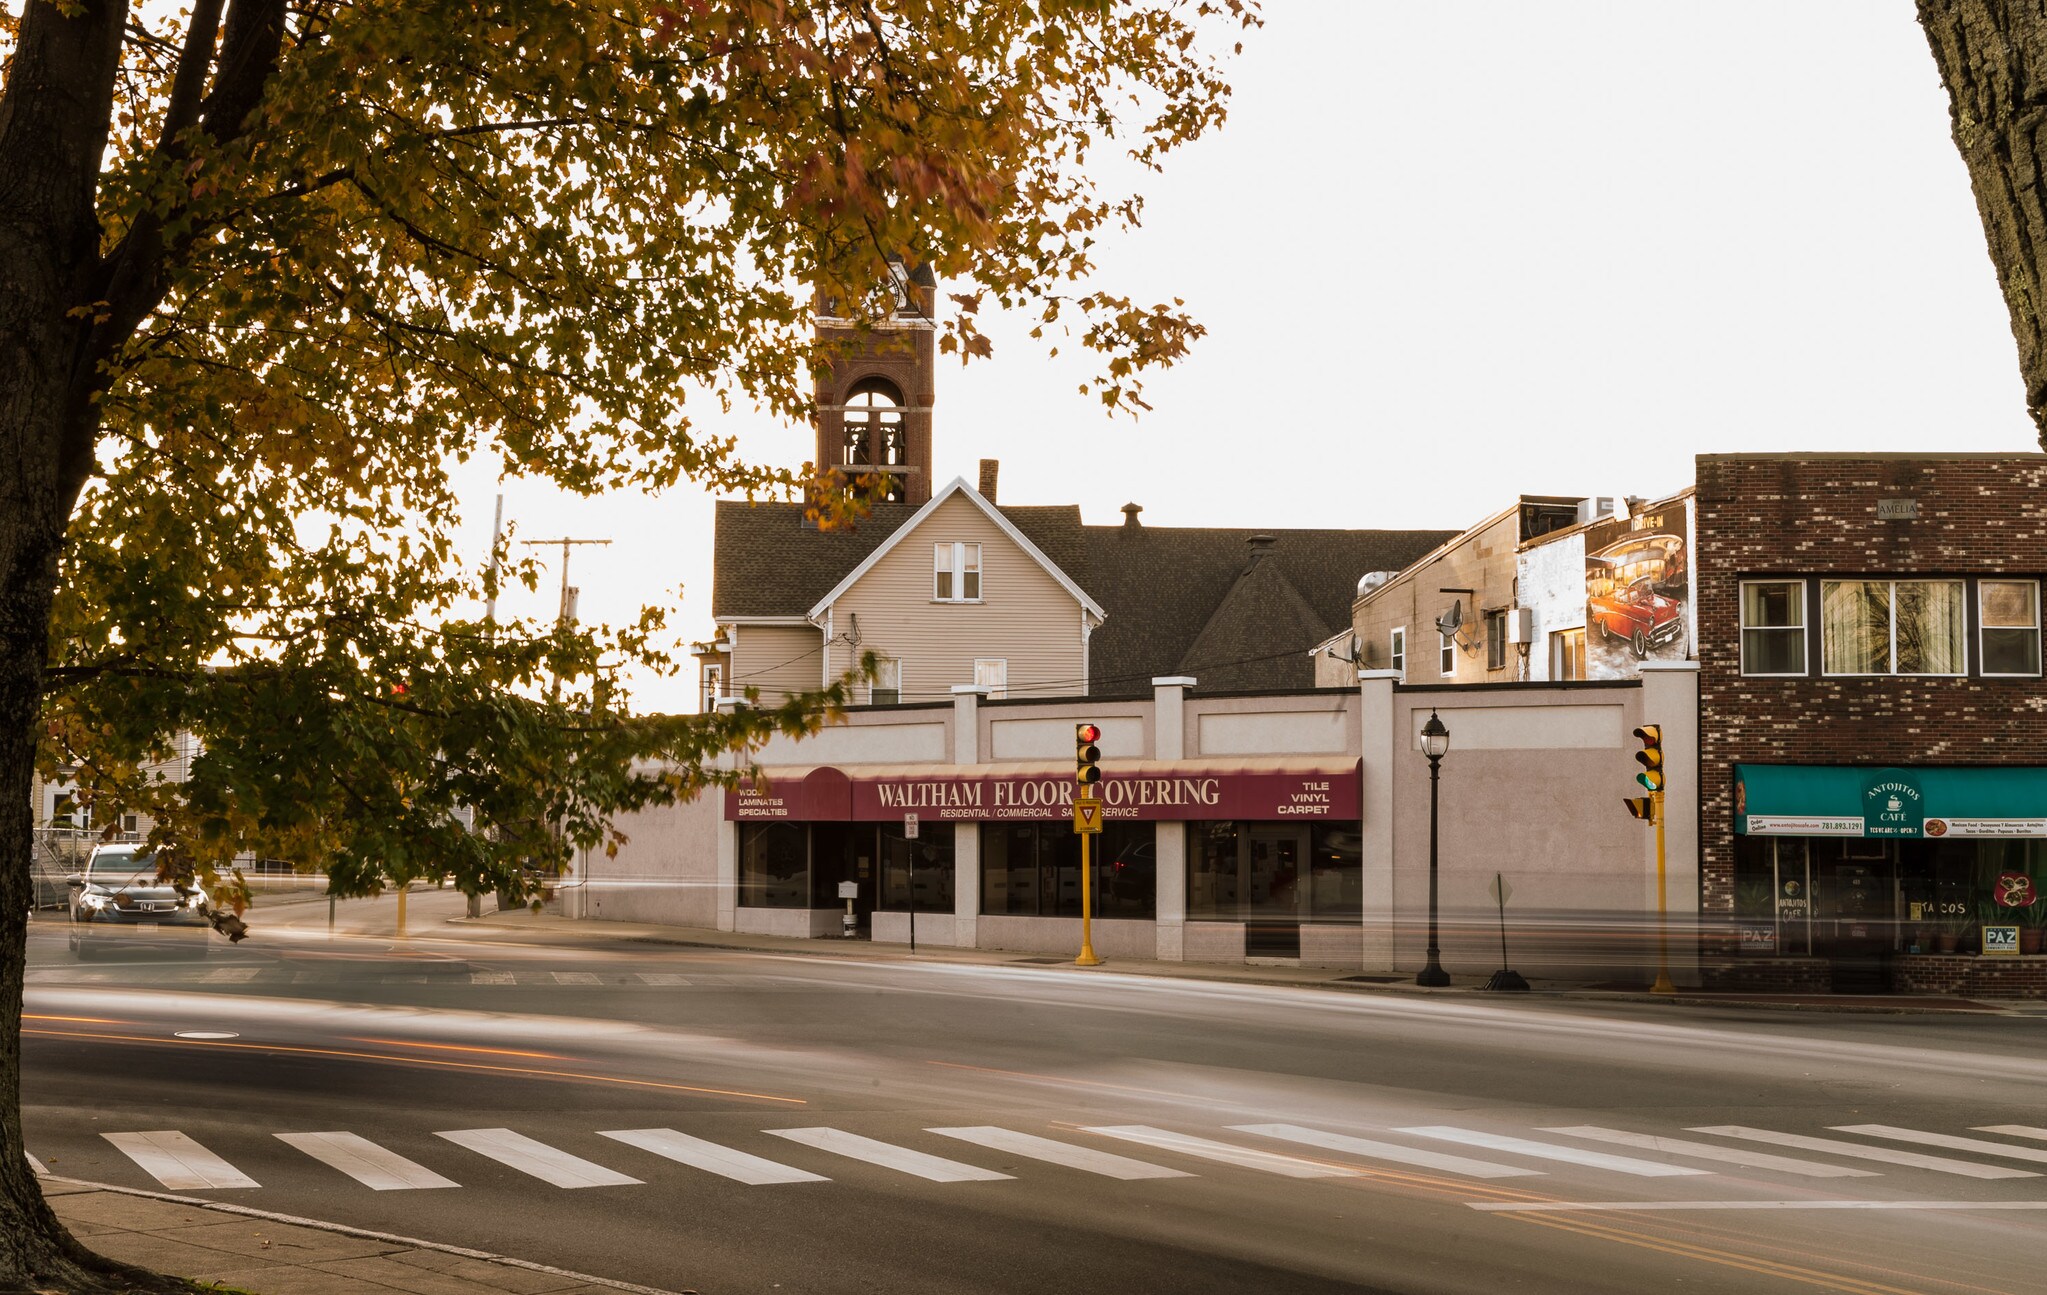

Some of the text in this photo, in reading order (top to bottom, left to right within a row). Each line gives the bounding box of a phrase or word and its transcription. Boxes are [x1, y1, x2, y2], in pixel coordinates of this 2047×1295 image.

[1880, 504, 1916, 514] AMELIA
[1302, 782, 1330, 791] TILE
[1868, 782, 1921, 801] ANTOJITOS
[877, 778, 1220, 807] WALTHAM FLOOR COVERING
[1290, 793, 1330, 802] VINYL
[738, 798, 784, 806] LAMINATES
[738, 808, 788, 816] SPECIALTIES
[940, 808, 990, 818] RESIDENTIAL
[996, 808, 1053, 818] COMMERCIAL
[1101, 807, 1139, 817] SERVICE
[1277, 805, 1330, 814] CARPET
[1880, 811, 1907, 822] CAFÉ
[1821, 822, 1863, 830] 781.893.1291
[1743, 930, 1773, 942] PAZ
[1987, 931, 2016, 943] PAZ
